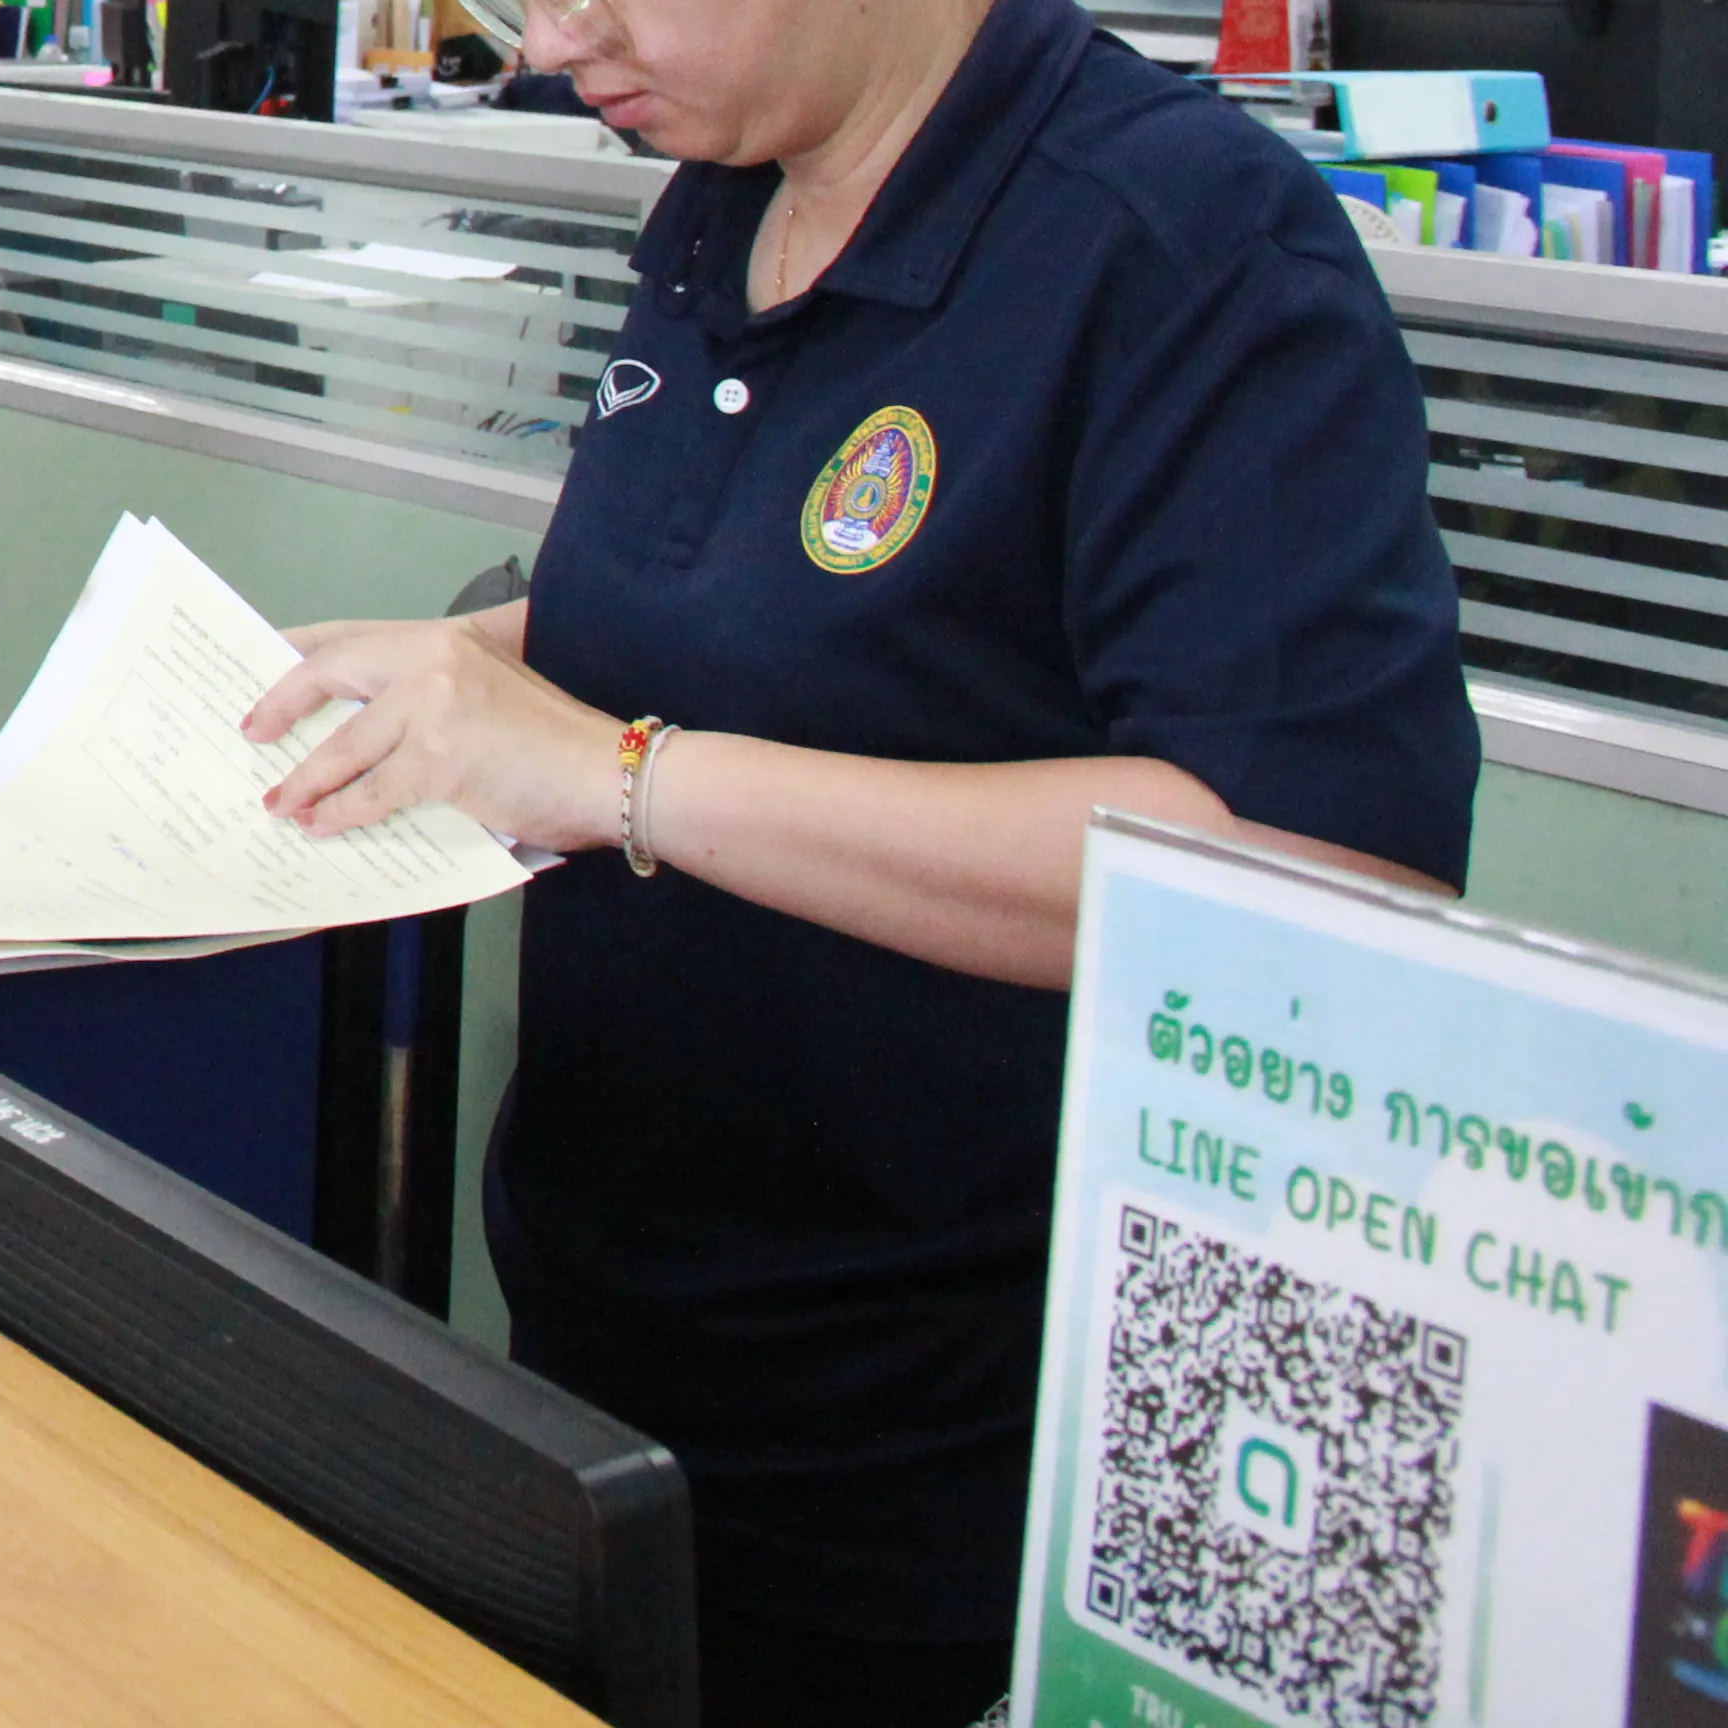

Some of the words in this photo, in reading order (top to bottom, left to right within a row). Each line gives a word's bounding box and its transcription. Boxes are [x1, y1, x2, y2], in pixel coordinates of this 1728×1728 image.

[1147, 987, 1355, 1120] ตัวอย่าง
[1138, 1106, 1258, 1202] LINE
[1286, 1165, 1438, 1267] OPEN
[1464, 1232, 1632, 1334] CHAT
